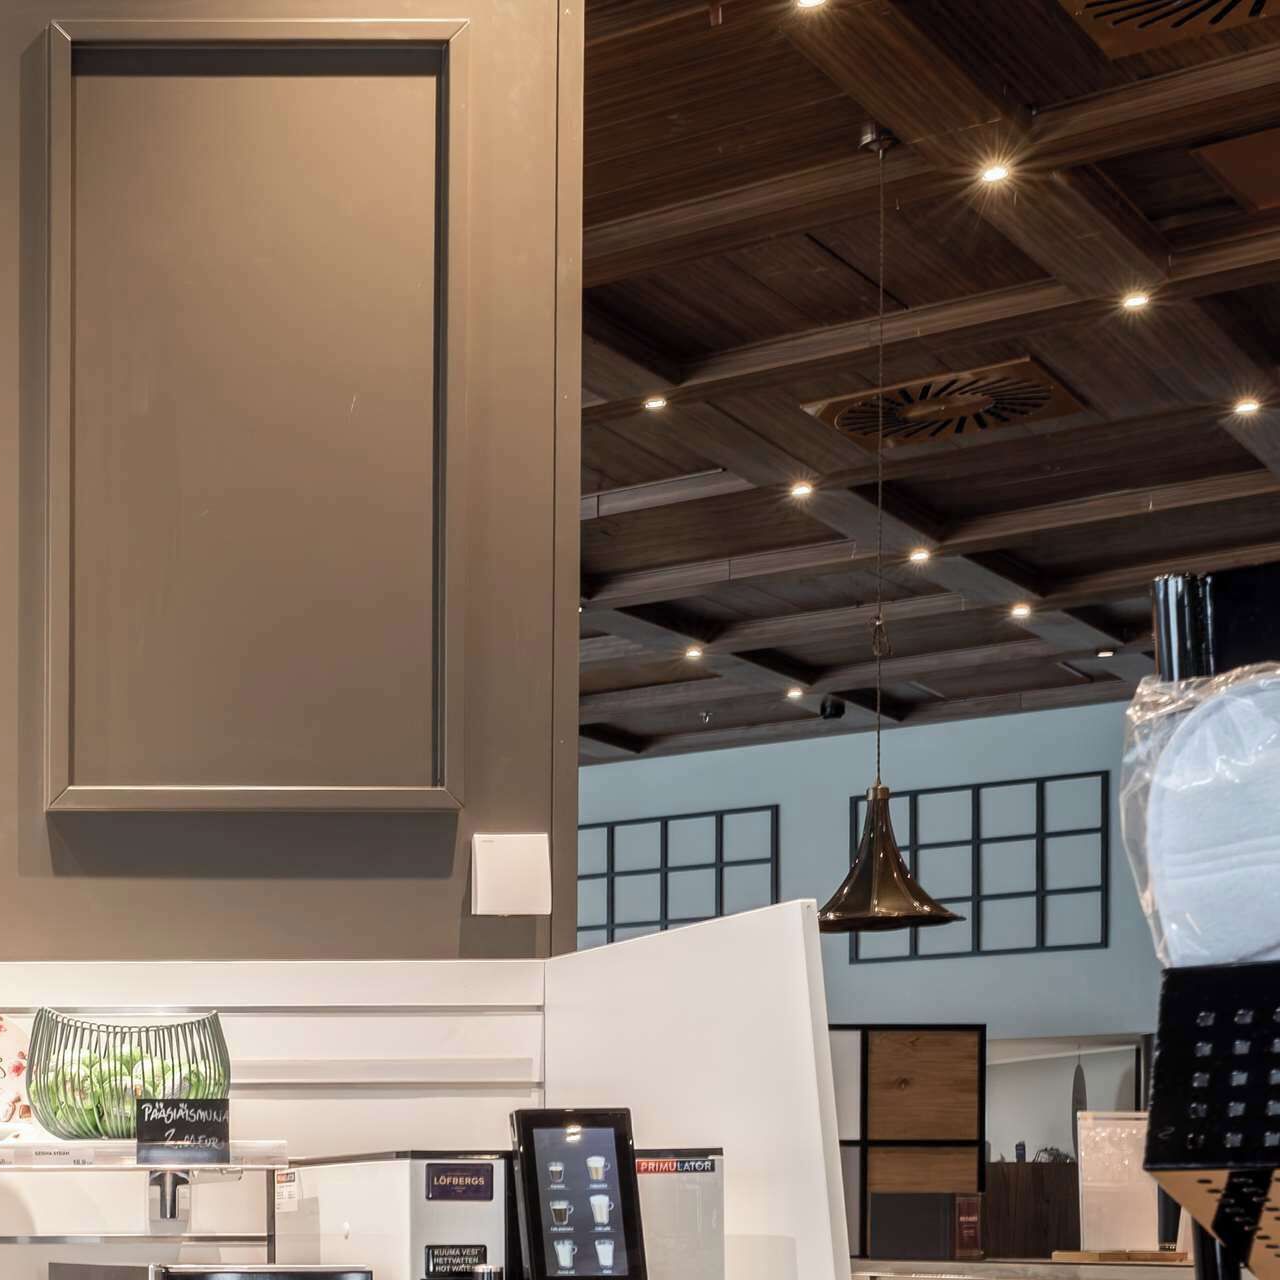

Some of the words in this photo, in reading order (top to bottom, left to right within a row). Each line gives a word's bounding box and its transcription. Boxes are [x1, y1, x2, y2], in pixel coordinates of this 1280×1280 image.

[641, 1160, 712, 1172] PRIMULATOR
[433, 1175, 485, 1185] LÖFBERGS
[434, 1248, 460, 1256] KUUMA
[451, 1264, 475, 1272] WATE
